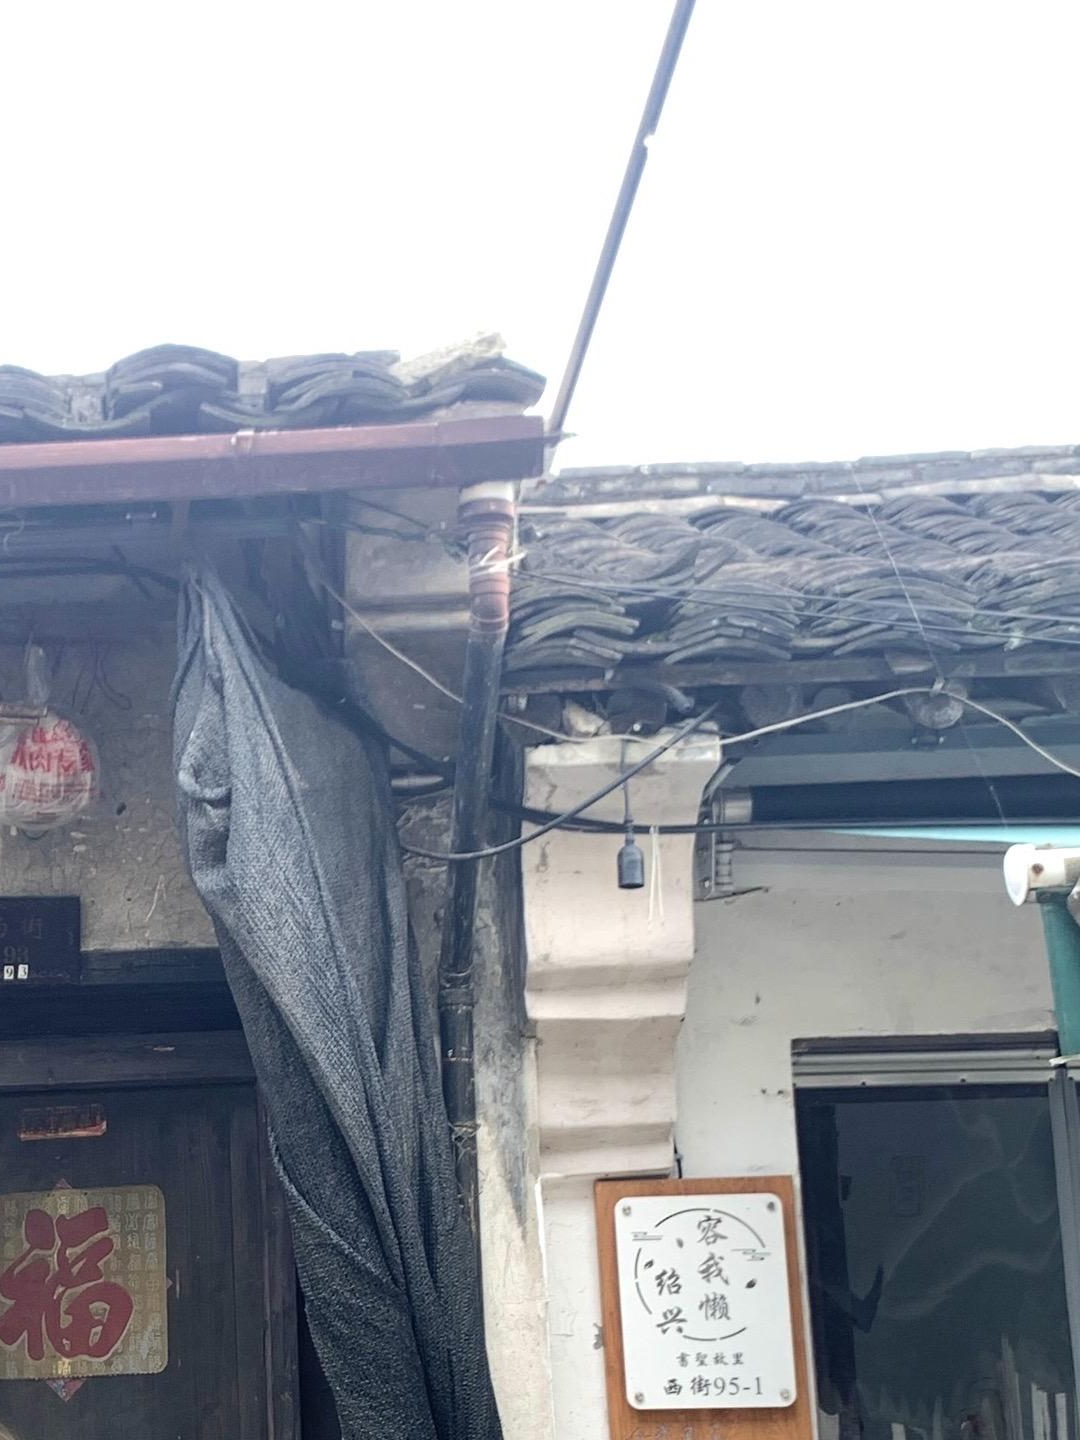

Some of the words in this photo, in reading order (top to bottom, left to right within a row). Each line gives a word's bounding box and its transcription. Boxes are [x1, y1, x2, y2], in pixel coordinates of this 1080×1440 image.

[655, 1268, 687, 1334] 绍兴
[697, 1215, 730, 1321] 容我懒
